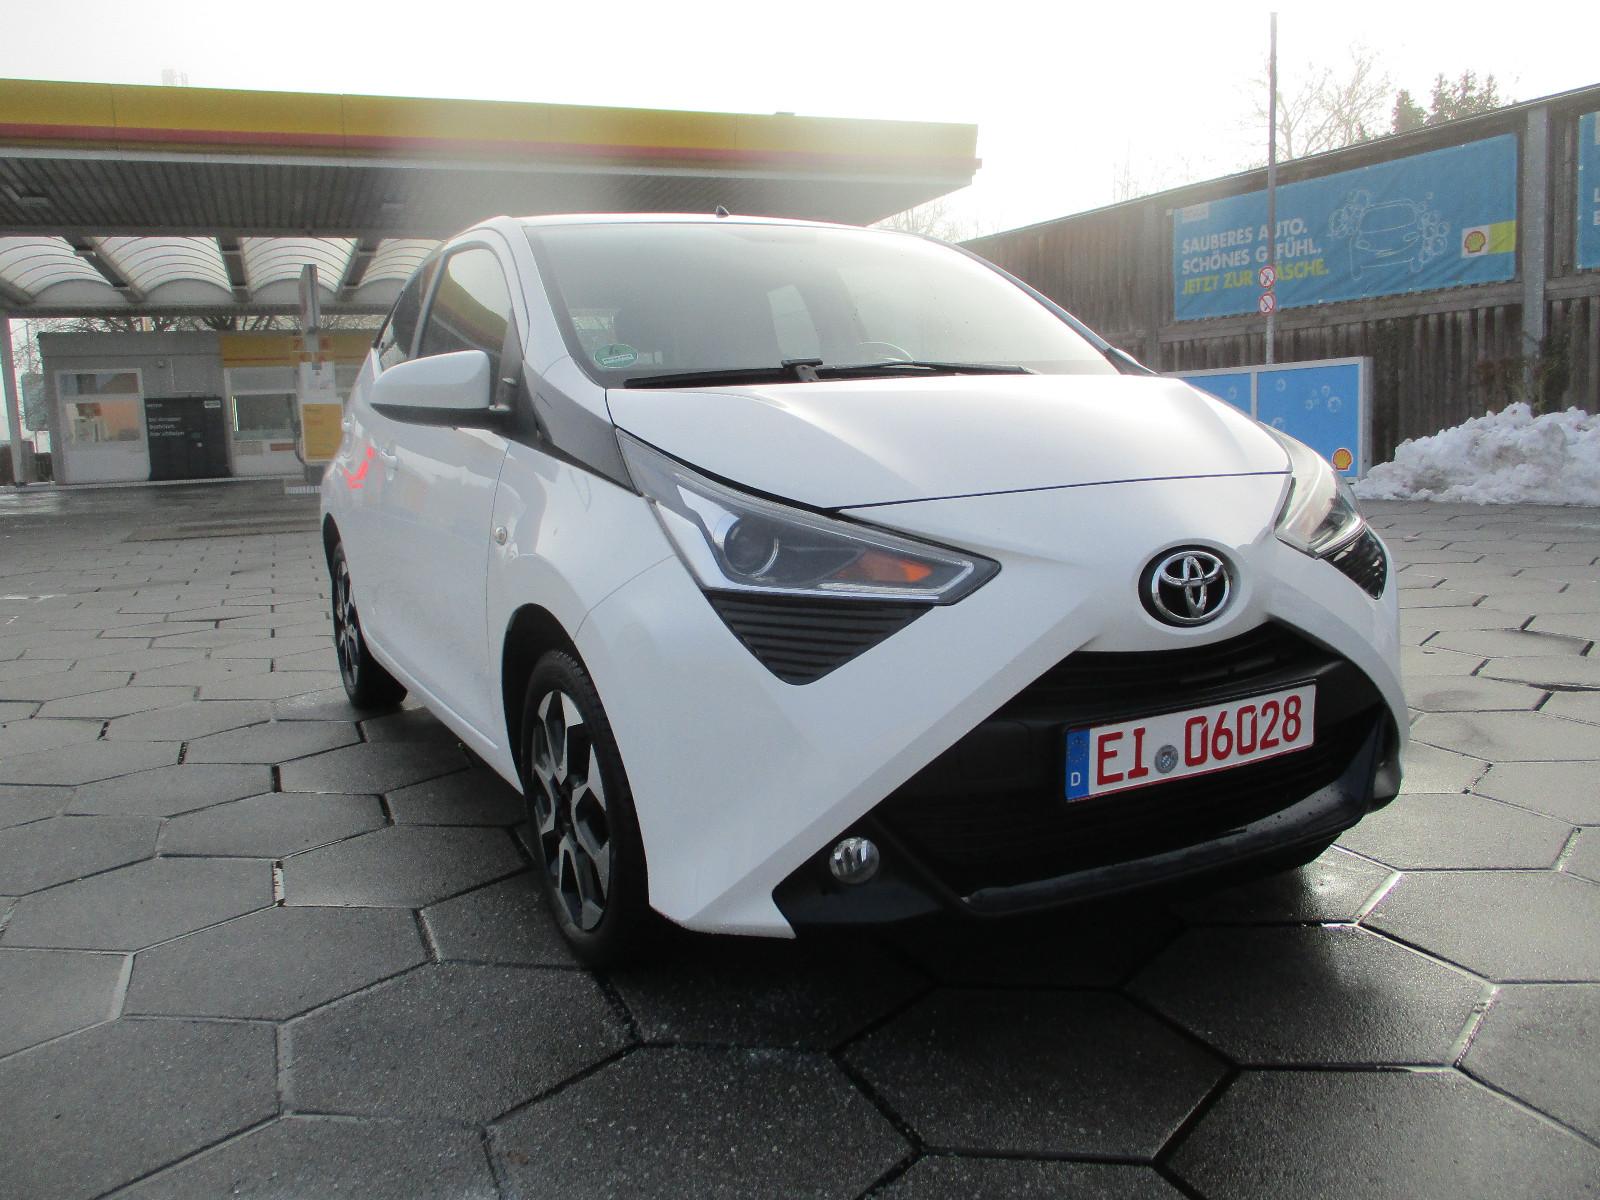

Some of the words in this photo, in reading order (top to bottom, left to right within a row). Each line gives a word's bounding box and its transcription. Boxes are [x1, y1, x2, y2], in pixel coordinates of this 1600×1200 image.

[1182, 227, 1252, 254] SAUBERES
[1182, 249, 1250, 276] SCHÖNES
[1183, 273, 1219, 295] JETZT
[1223, 269, 1253, 289] ZUR
[1268, 257, 1329, 282] ÄSCHE.
[1097, 727, 1149, 786] EI
[1184, 695, 1302, 768] 06028
[1070, 771, 1081, 787] D
